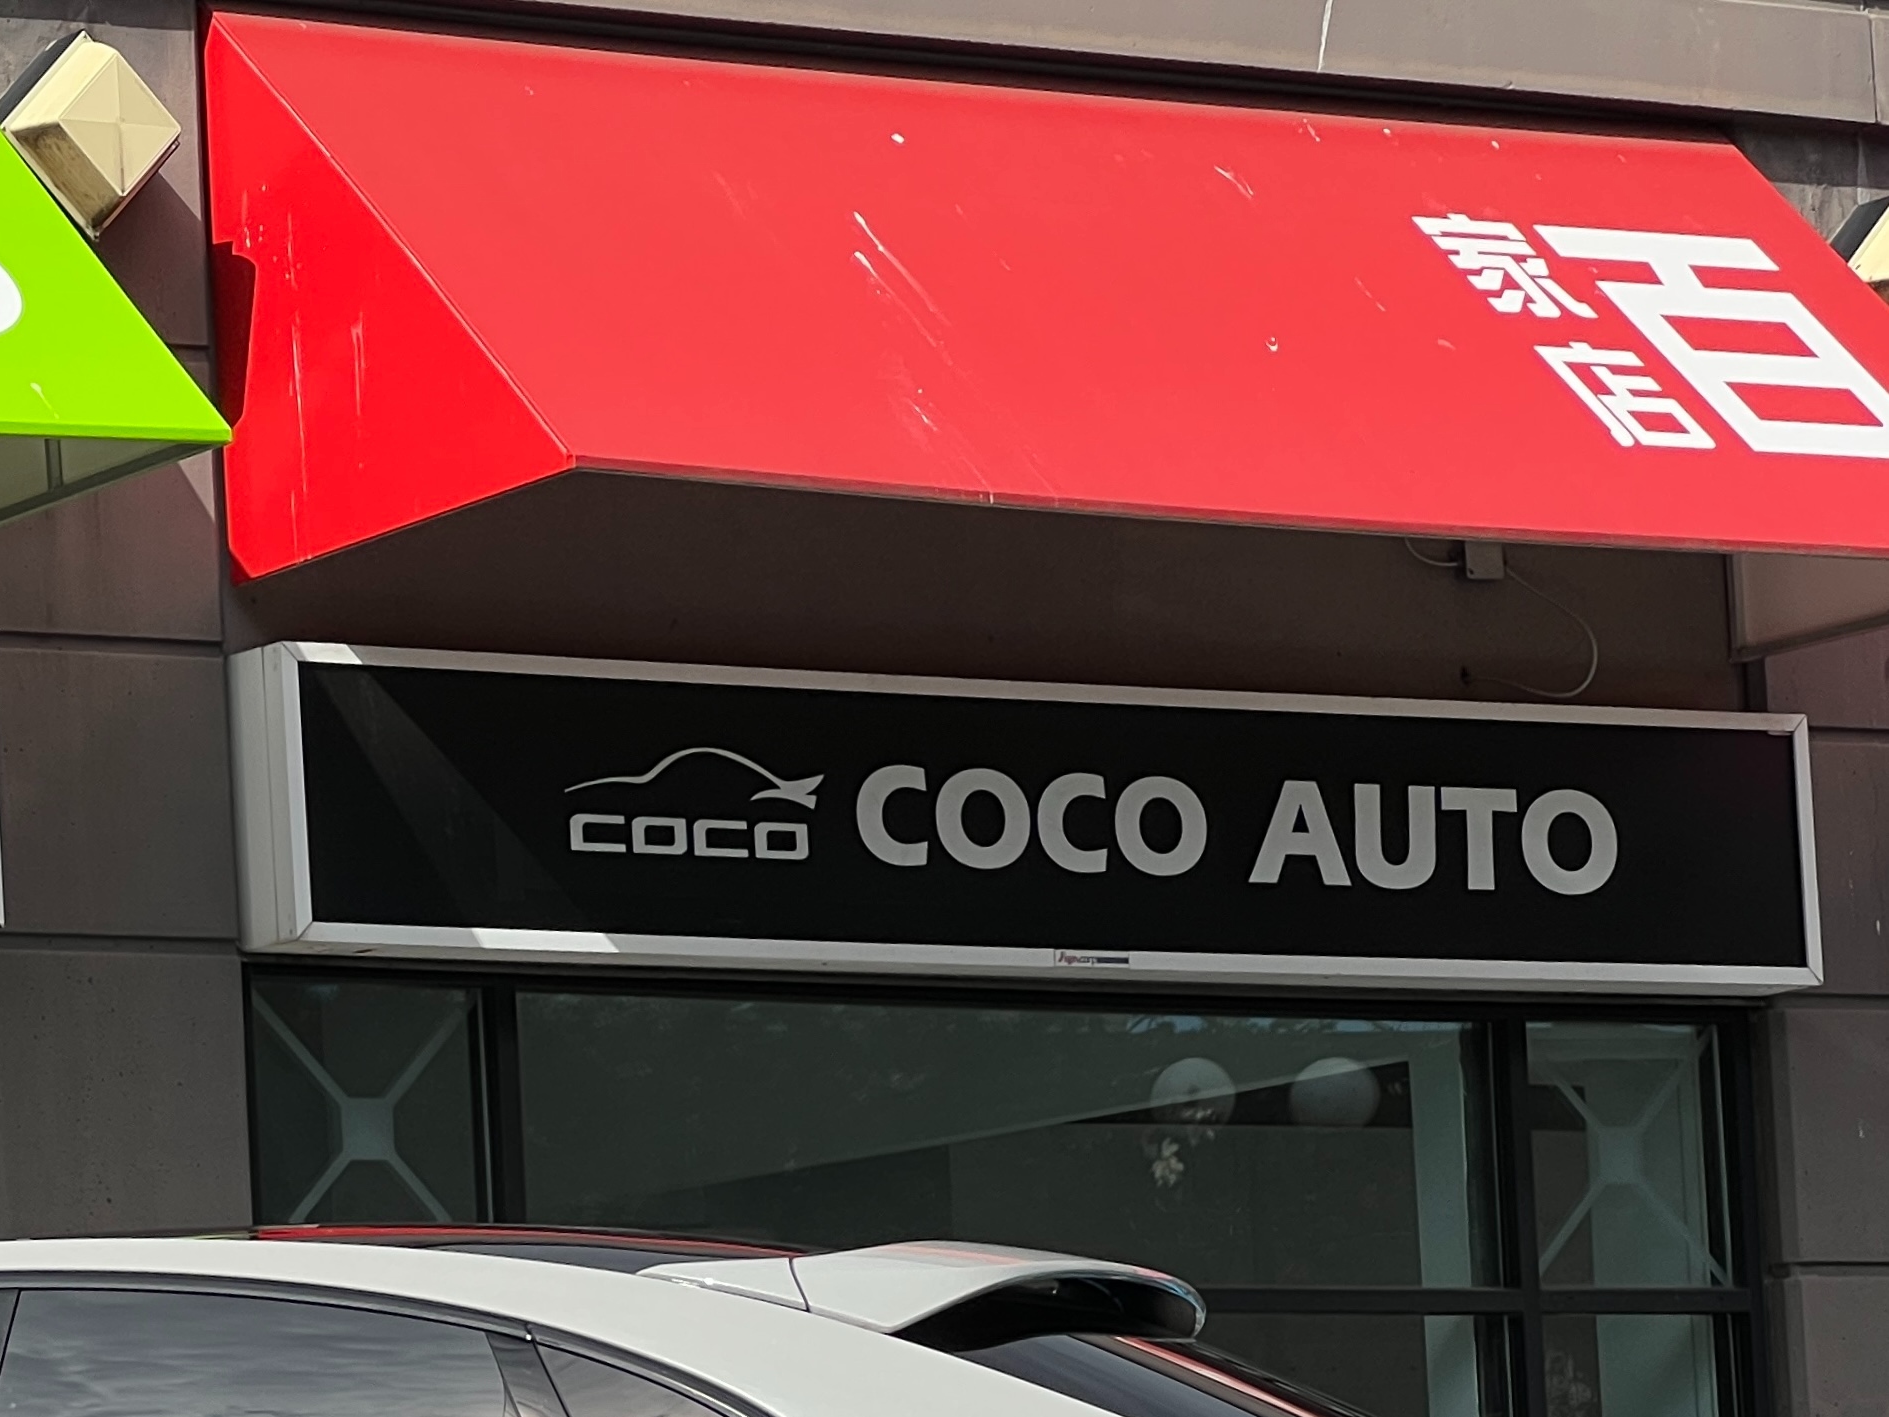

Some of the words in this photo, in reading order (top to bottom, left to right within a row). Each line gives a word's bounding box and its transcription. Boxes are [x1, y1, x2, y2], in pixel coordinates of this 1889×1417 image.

[1532, 224, 1889, 460] 百
[569, 813, 809, 860] COCO
[856, 764, 1208, 877] COCO
[1248, 780, 1618, 896] AUTO
